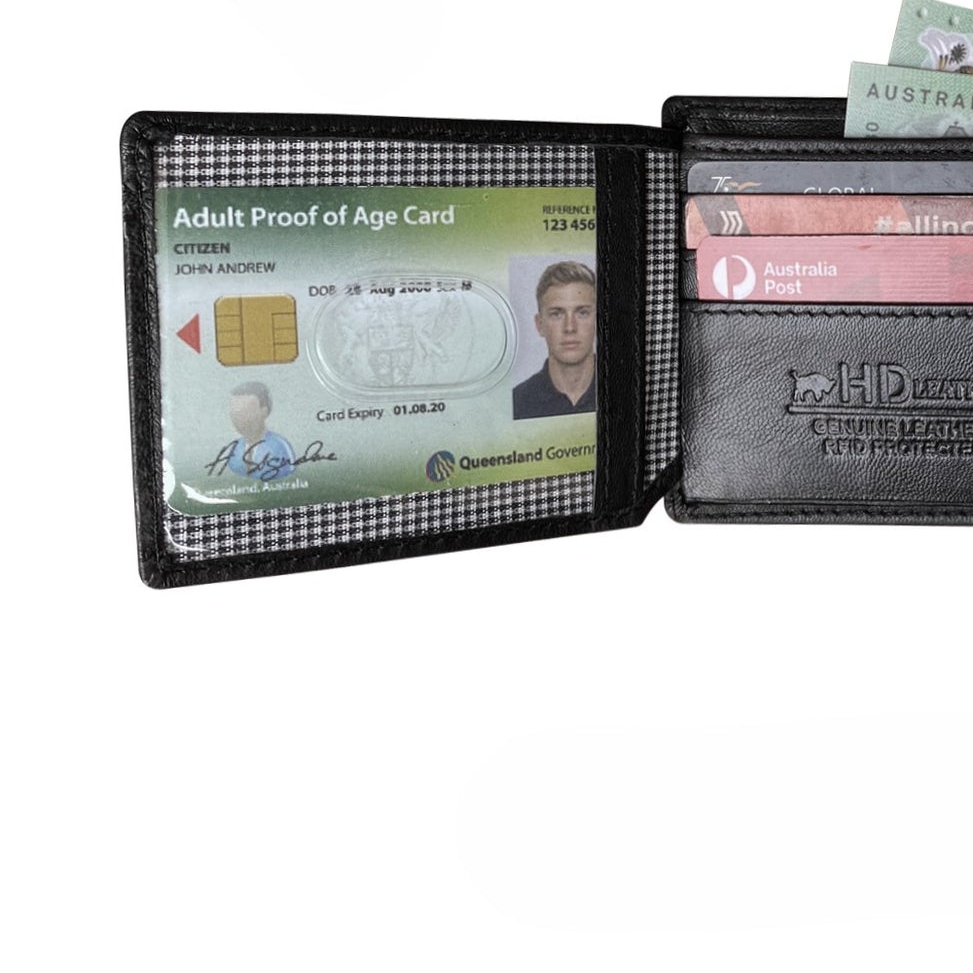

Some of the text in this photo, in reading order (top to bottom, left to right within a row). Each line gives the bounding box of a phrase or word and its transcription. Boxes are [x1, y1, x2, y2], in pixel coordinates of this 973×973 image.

[173, 205, 455, 231] Adult Proof of Age Card
[543, 219, 596, 231] 123 456
[173, 242, 231, 255] CITIZEN
[175, 262, 276, 276] JOHN ANDREW
[763, 261, 838, 277] Australia
[308, 285, 337, 297] DOB
[765, 279, 803, 295] Post
[839, 363, 913, 404] HD
[317, 402, 446, 422] Card Expiry 01.08.20
[812, 418, 899, 436] GENUINE
[459, 448, 543, 470] Queensland
[262, 478, 309, 491] Australia
